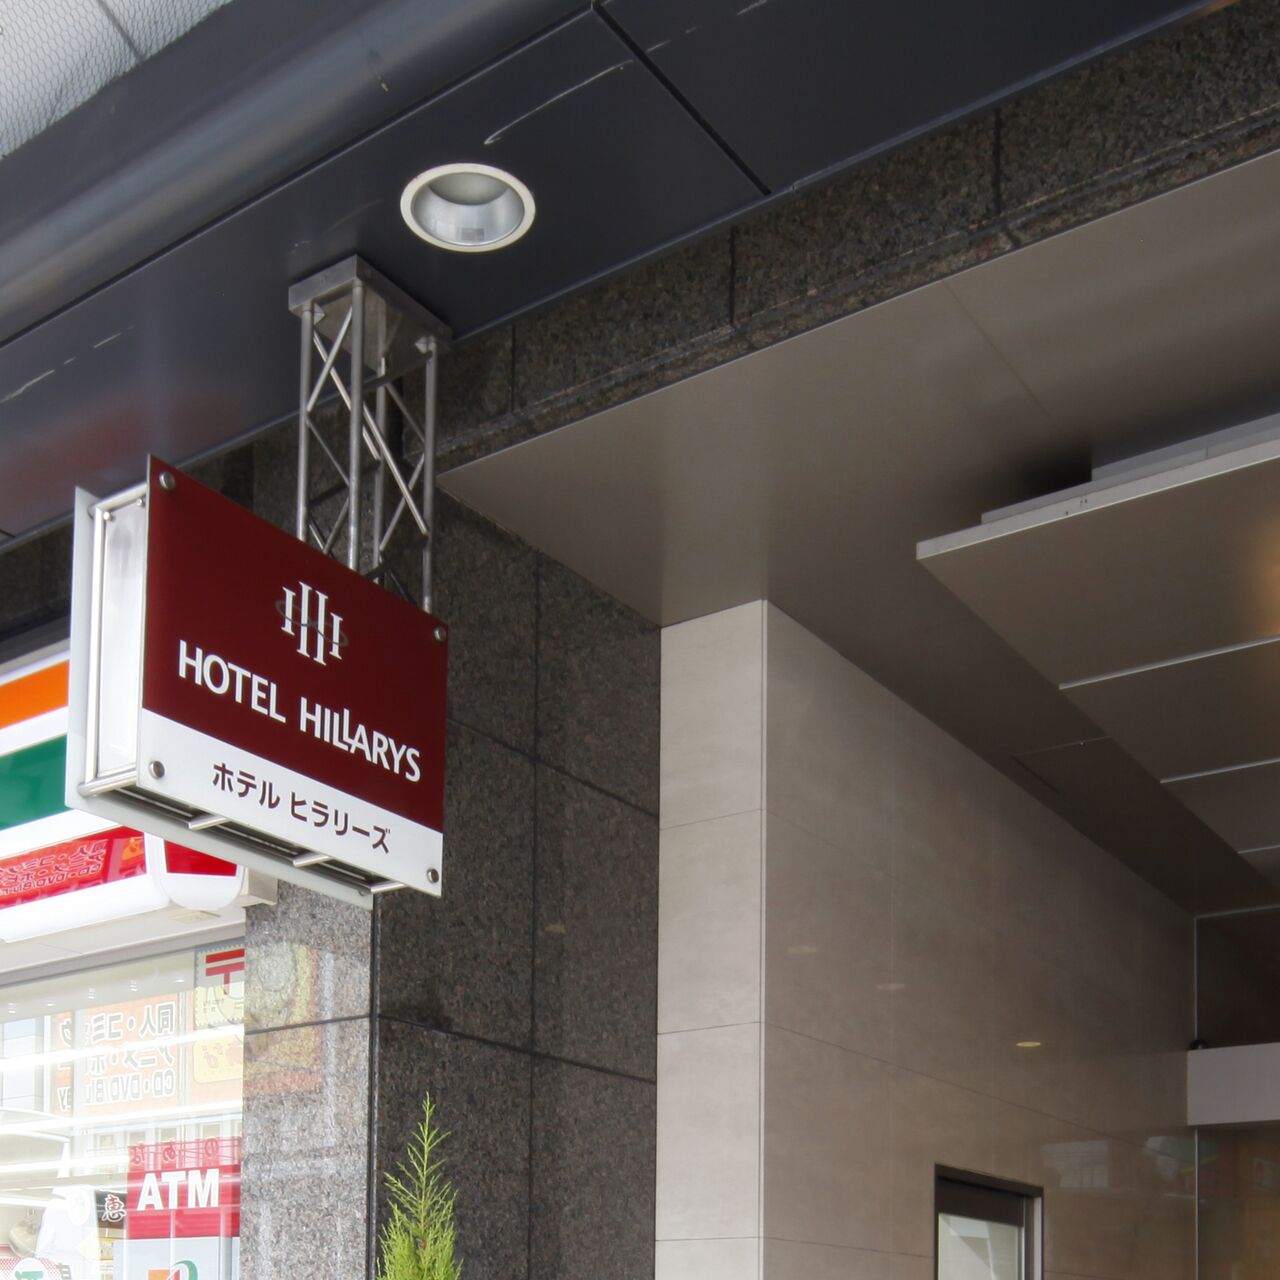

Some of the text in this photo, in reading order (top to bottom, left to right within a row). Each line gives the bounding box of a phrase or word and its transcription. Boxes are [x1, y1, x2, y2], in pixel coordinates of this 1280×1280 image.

[178, 640, 422, 783] HOTEL HILLARYS
[212, 762, 391, 854] ホテル ヒラリーズ
[137, 1168, 220, 1211] ATM
